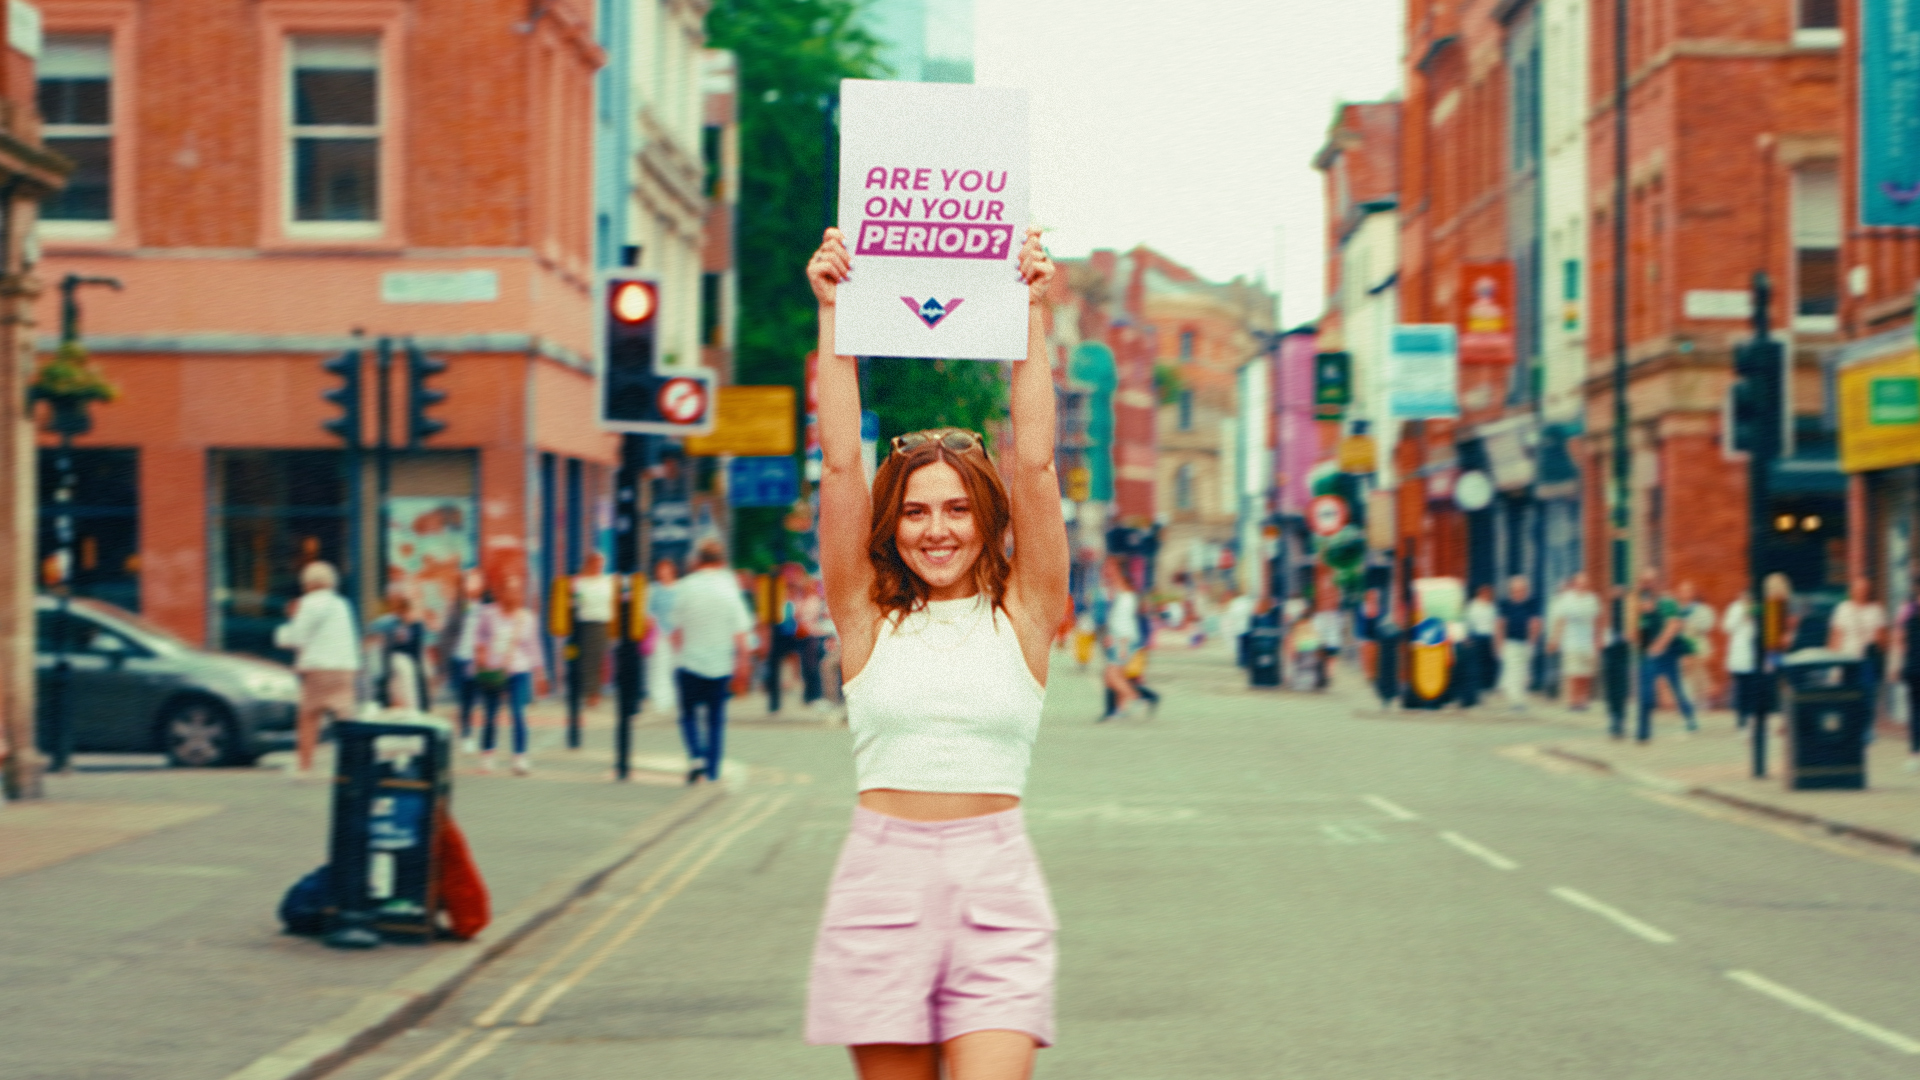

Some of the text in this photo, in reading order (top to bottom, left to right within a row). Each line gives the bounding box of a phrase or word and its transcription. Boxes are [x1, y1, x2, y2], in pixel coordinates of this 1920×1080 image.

[865, 166, 1007, 193] ARE YOU
[864, 196, 1005, 221] ON YOUR
[861, 226, 1008, 255] PERIOD?
